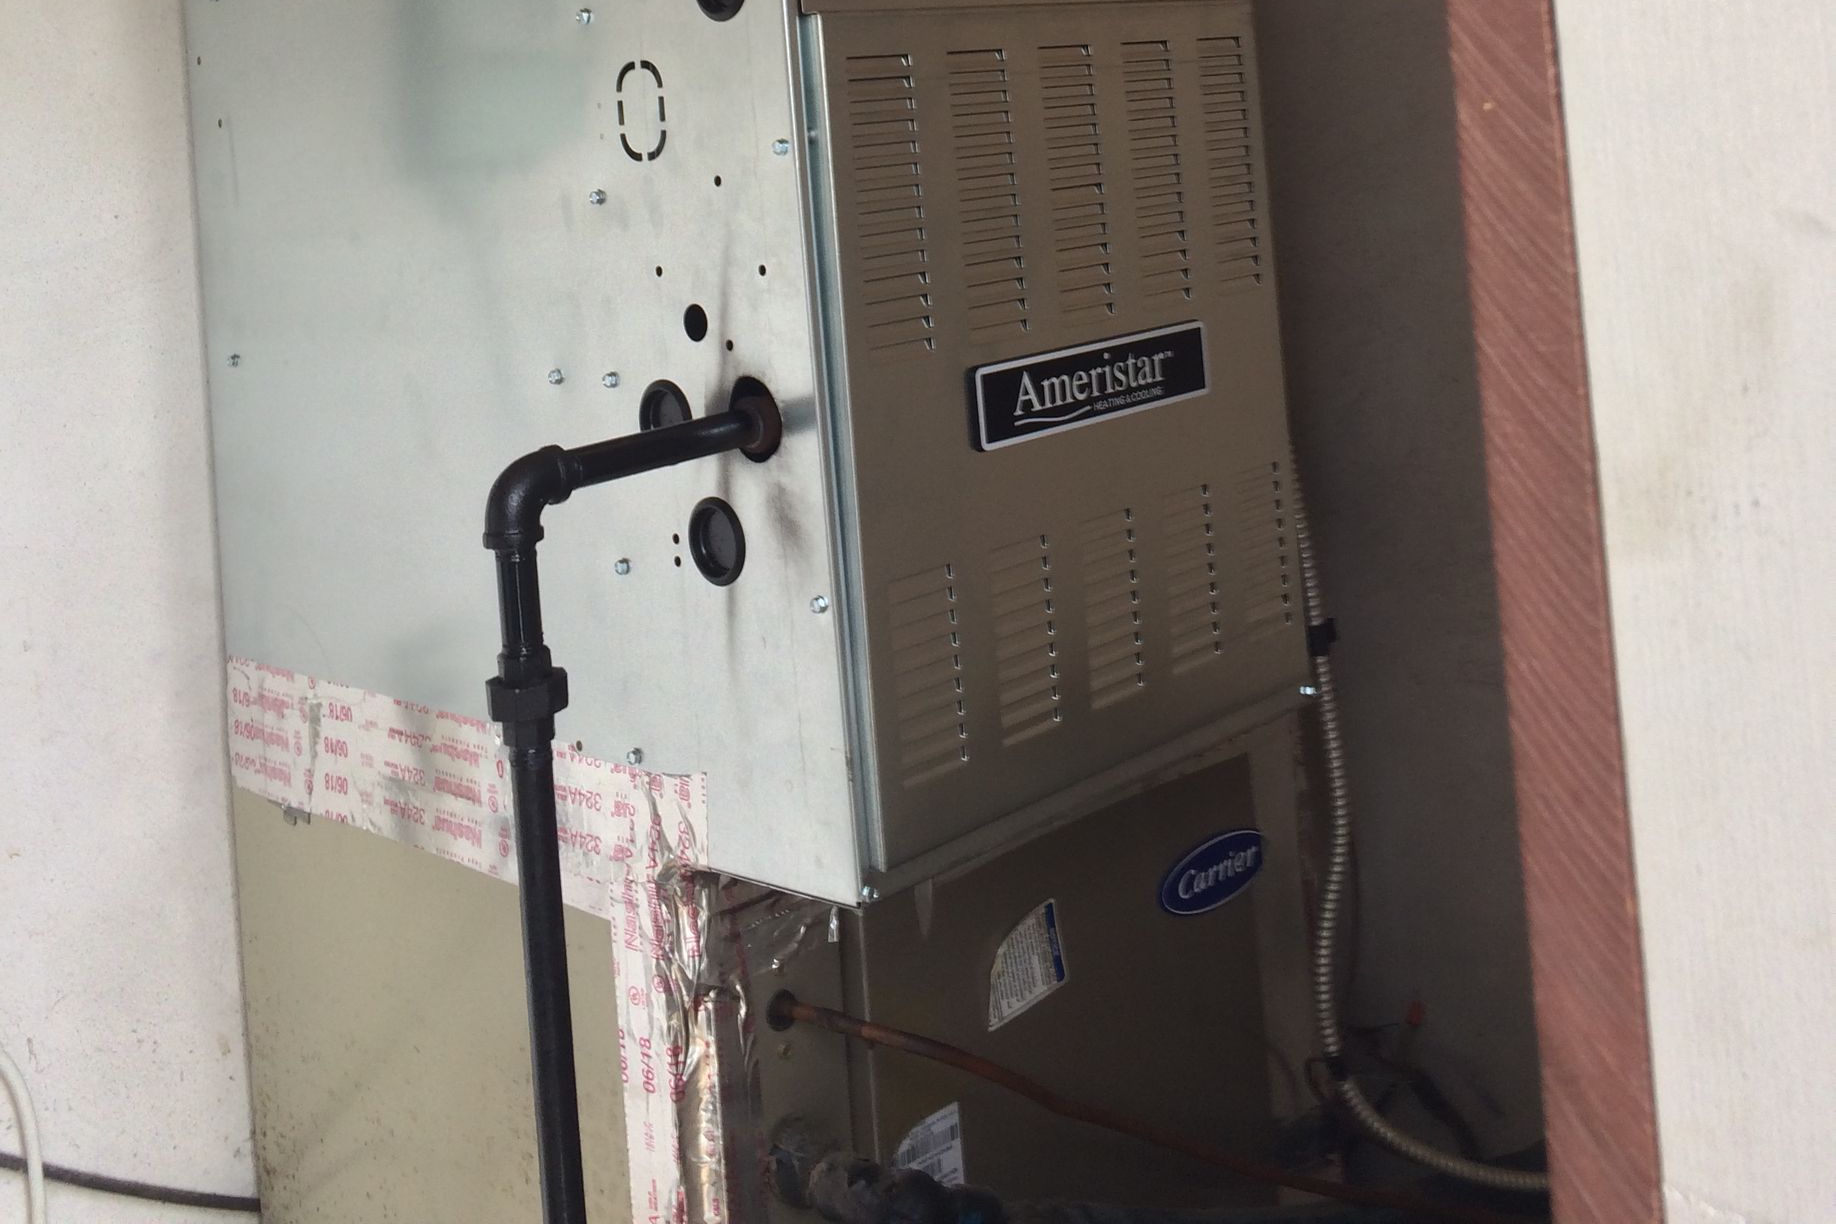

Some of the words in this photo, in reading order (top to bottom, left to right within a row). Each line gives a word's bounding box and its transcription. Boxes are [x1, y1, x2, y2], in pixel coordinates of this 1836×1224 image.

[1013, 352, 1166, 416] Ameristar
[1093, 396, 1125, 411] HEATING
[324, 737, 349, 759] 06/18
[324, 773, 349, 796] 06/18
[569, 786, 602, 812] 324A
[570, 830, 602, 855] 324A
[1178, 845, 1259, 899] Carrier
[639, 1037, 657, 1095] 06/18
